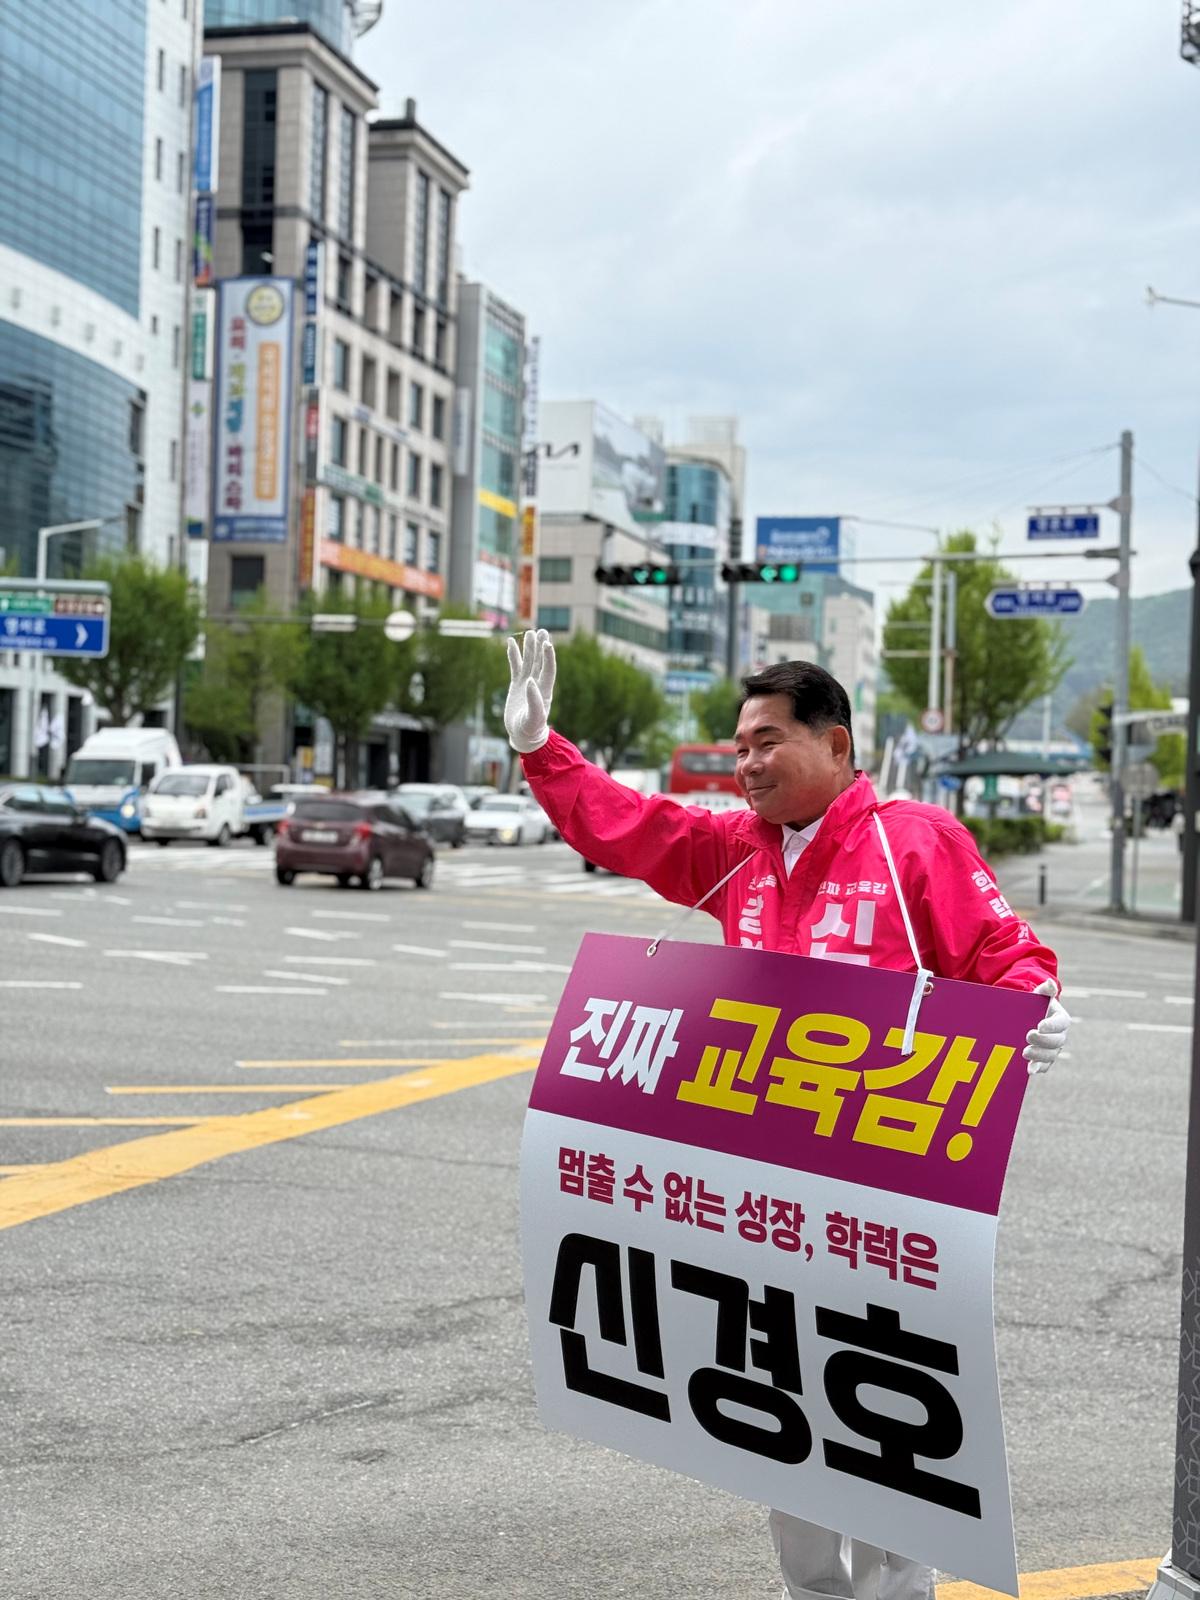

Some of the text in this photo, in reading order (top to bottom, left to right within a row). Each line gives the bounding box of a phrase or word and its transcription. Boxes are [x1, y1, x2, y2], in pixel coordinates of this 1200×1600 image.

[845, 880, 888, 896] 교육감
[560, 997, 1016, 1162] 진짜 교육감!
[558, 1147, 939, 1290] 멈출 수 없는 성장, 학력은
[549, 1233, 982, 1519] 신경호
